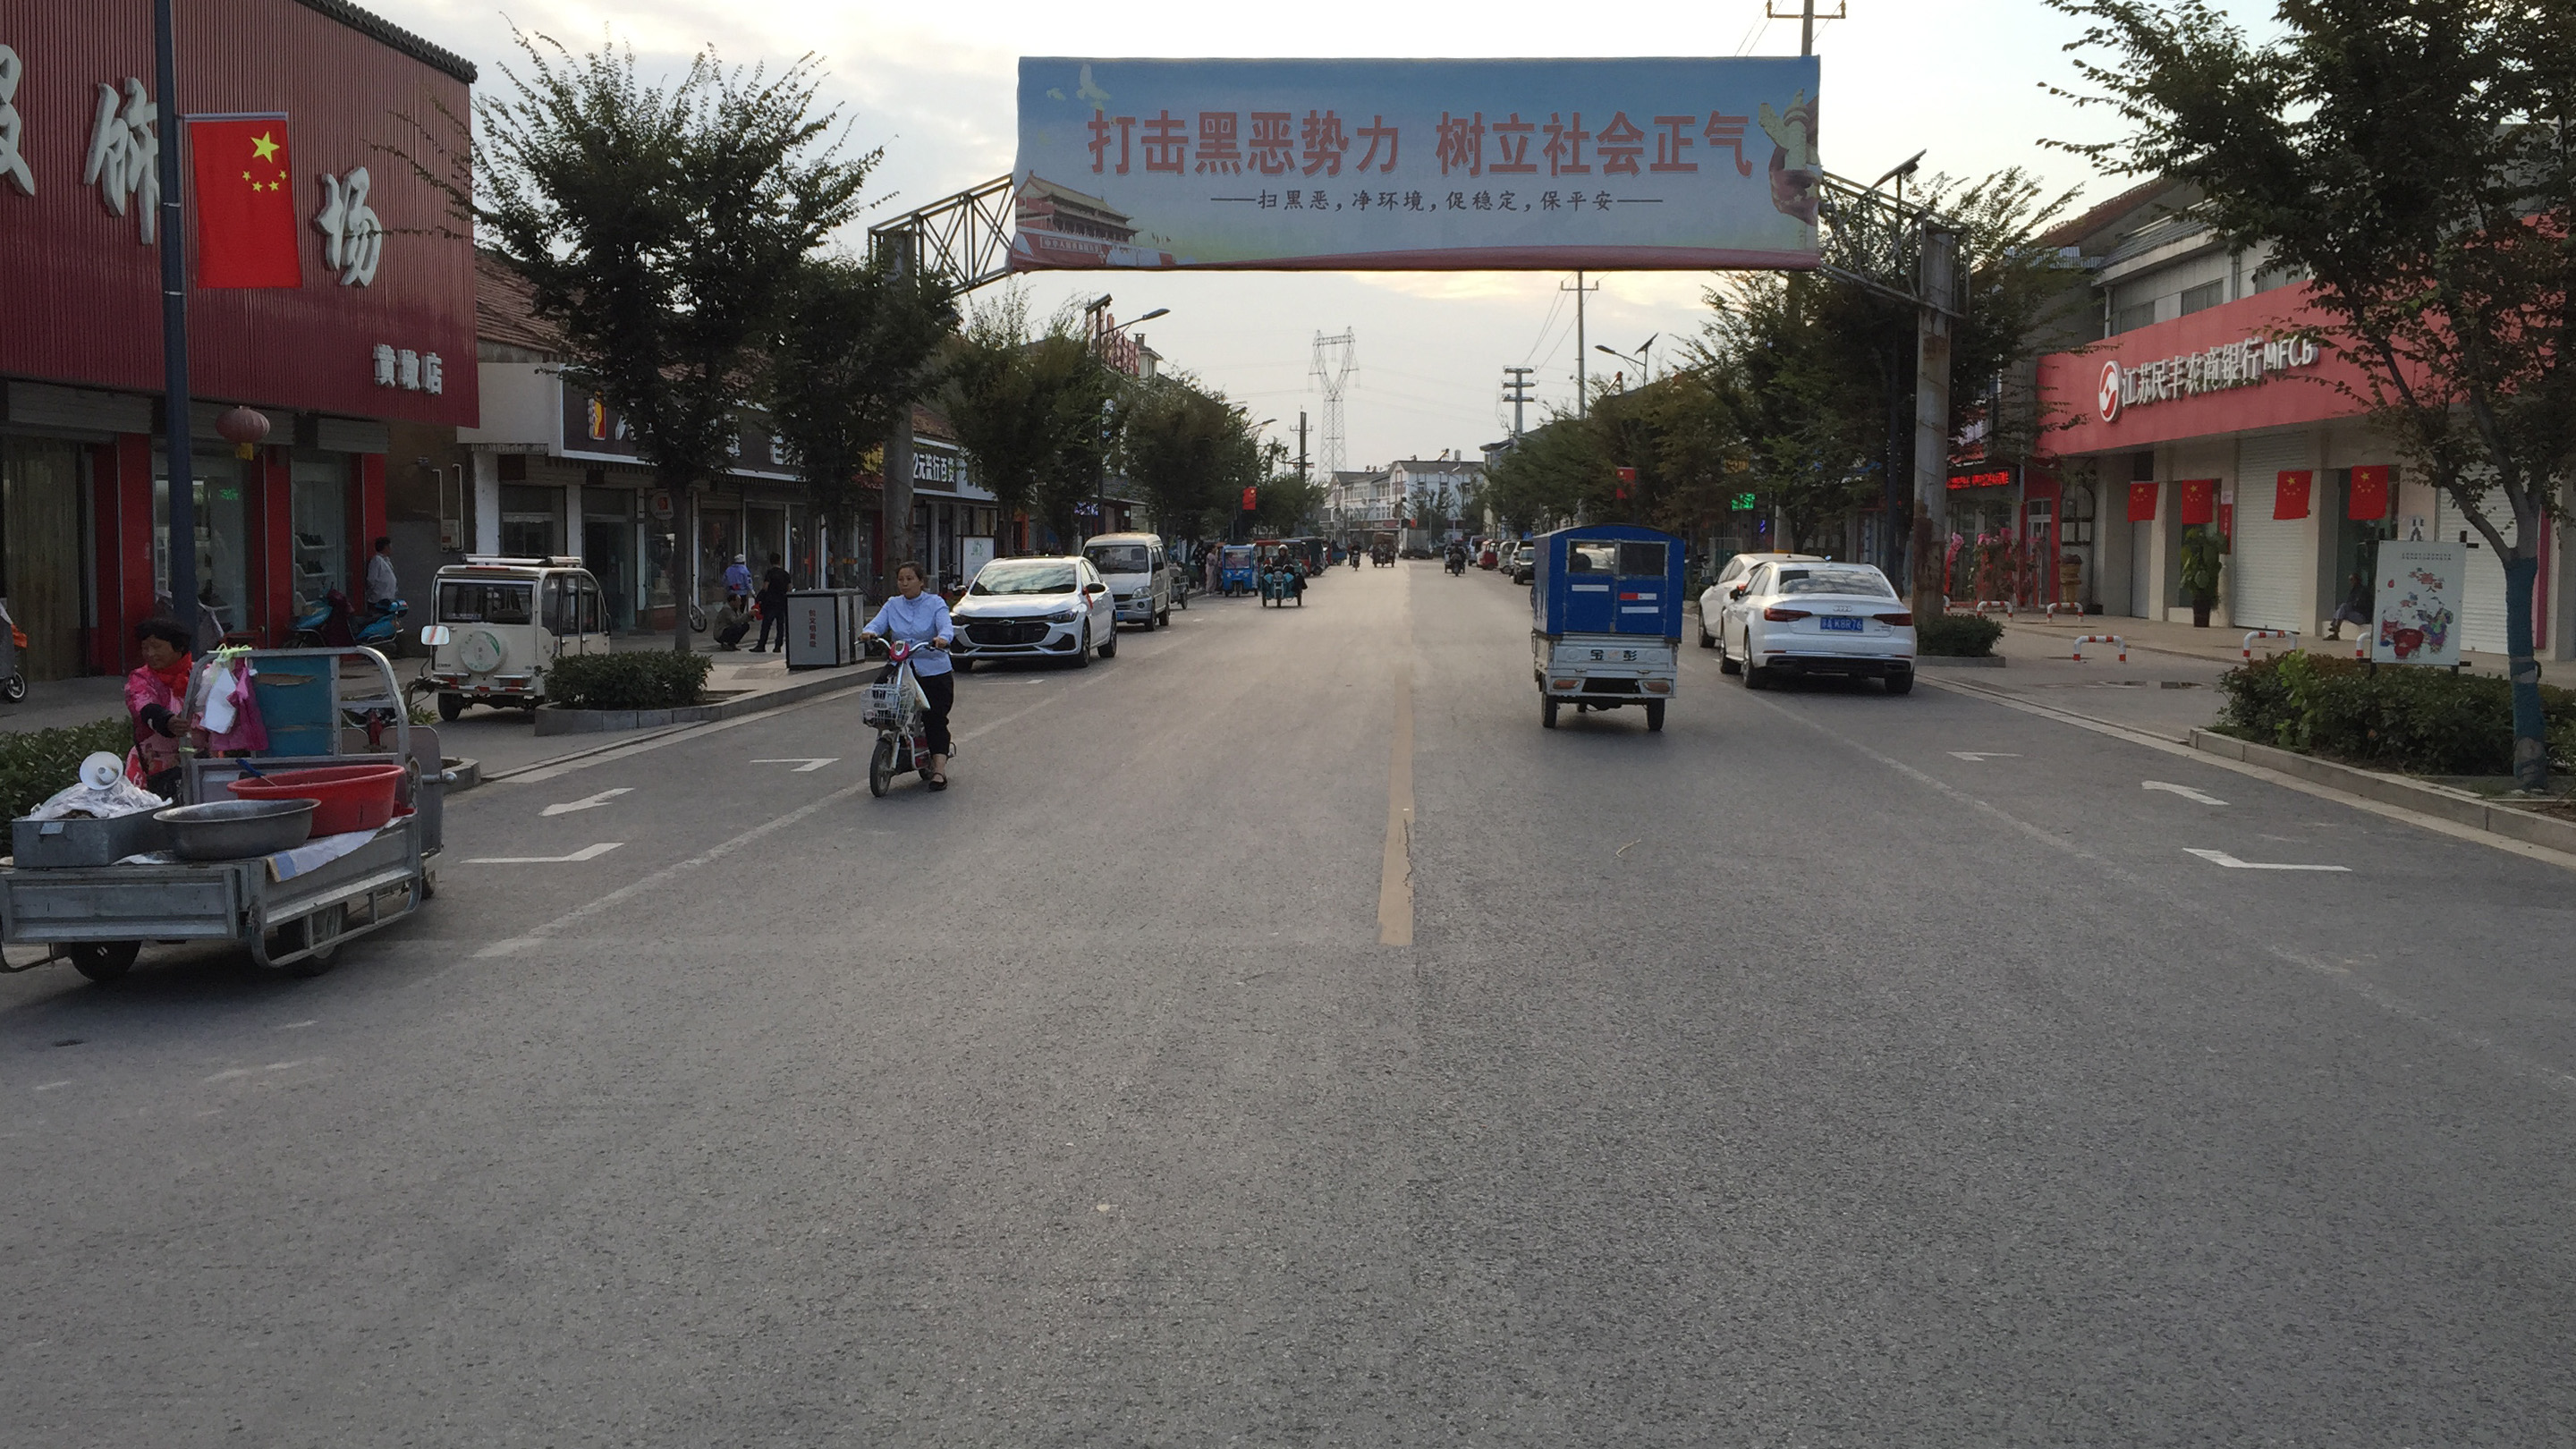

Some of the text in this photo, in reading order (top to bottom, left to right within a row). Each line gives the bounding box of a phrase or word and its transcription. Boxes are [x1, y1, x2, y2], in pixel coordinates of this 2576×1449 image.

[1088, 109, 1753, 178] 打击黑恶势力 树立社会正气
